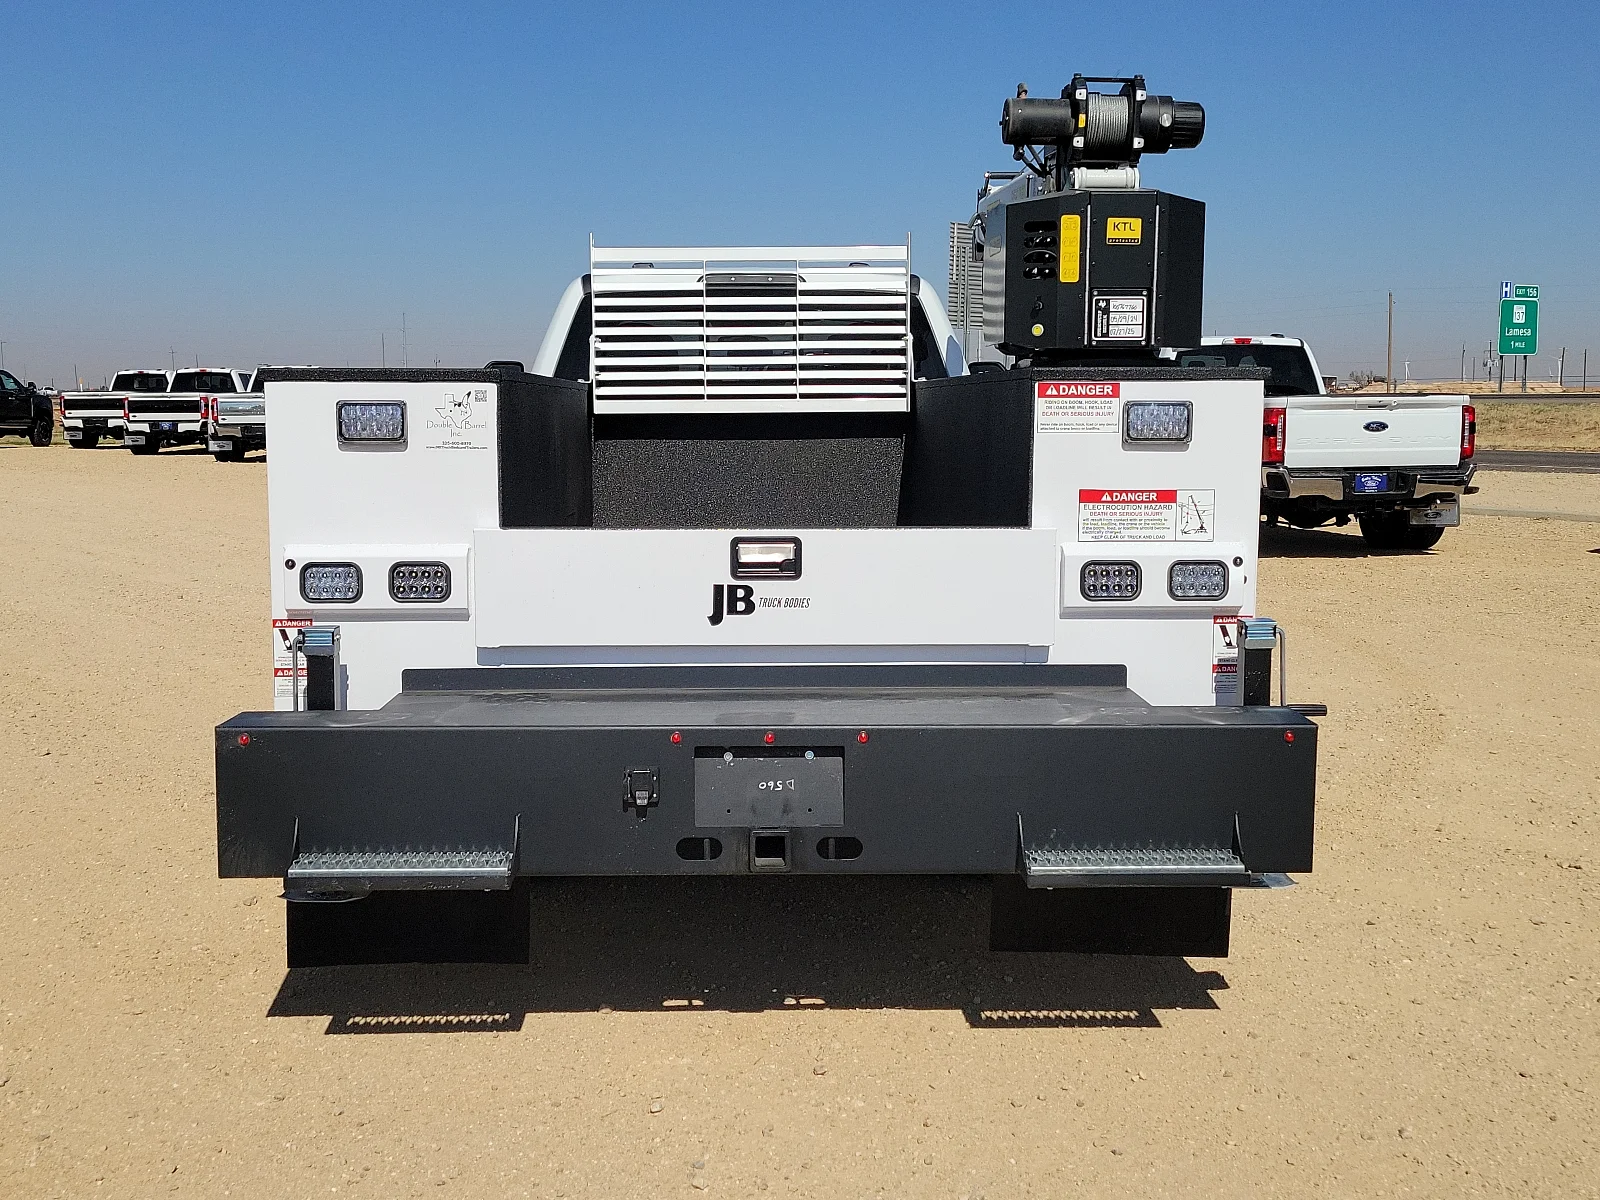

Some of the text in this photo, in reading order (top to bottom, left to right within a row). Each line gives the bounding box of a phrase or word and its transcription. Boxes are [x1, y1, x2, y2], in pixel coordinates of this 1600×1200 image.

[1113, 222, 1135, 231] KTL
[1502, 282, 1510, 298] H
[1527, 288, 1537, 296] 156
[1505, 327, 1532, 336] Lamesa
[1060, 385, 1113, 395] DANGER
[427, 420, 486, 429] Double Barrel
[1113, 493, 1157, 501] DANGER
[707, 584, 810, 626] JB TRUCK BODIES
